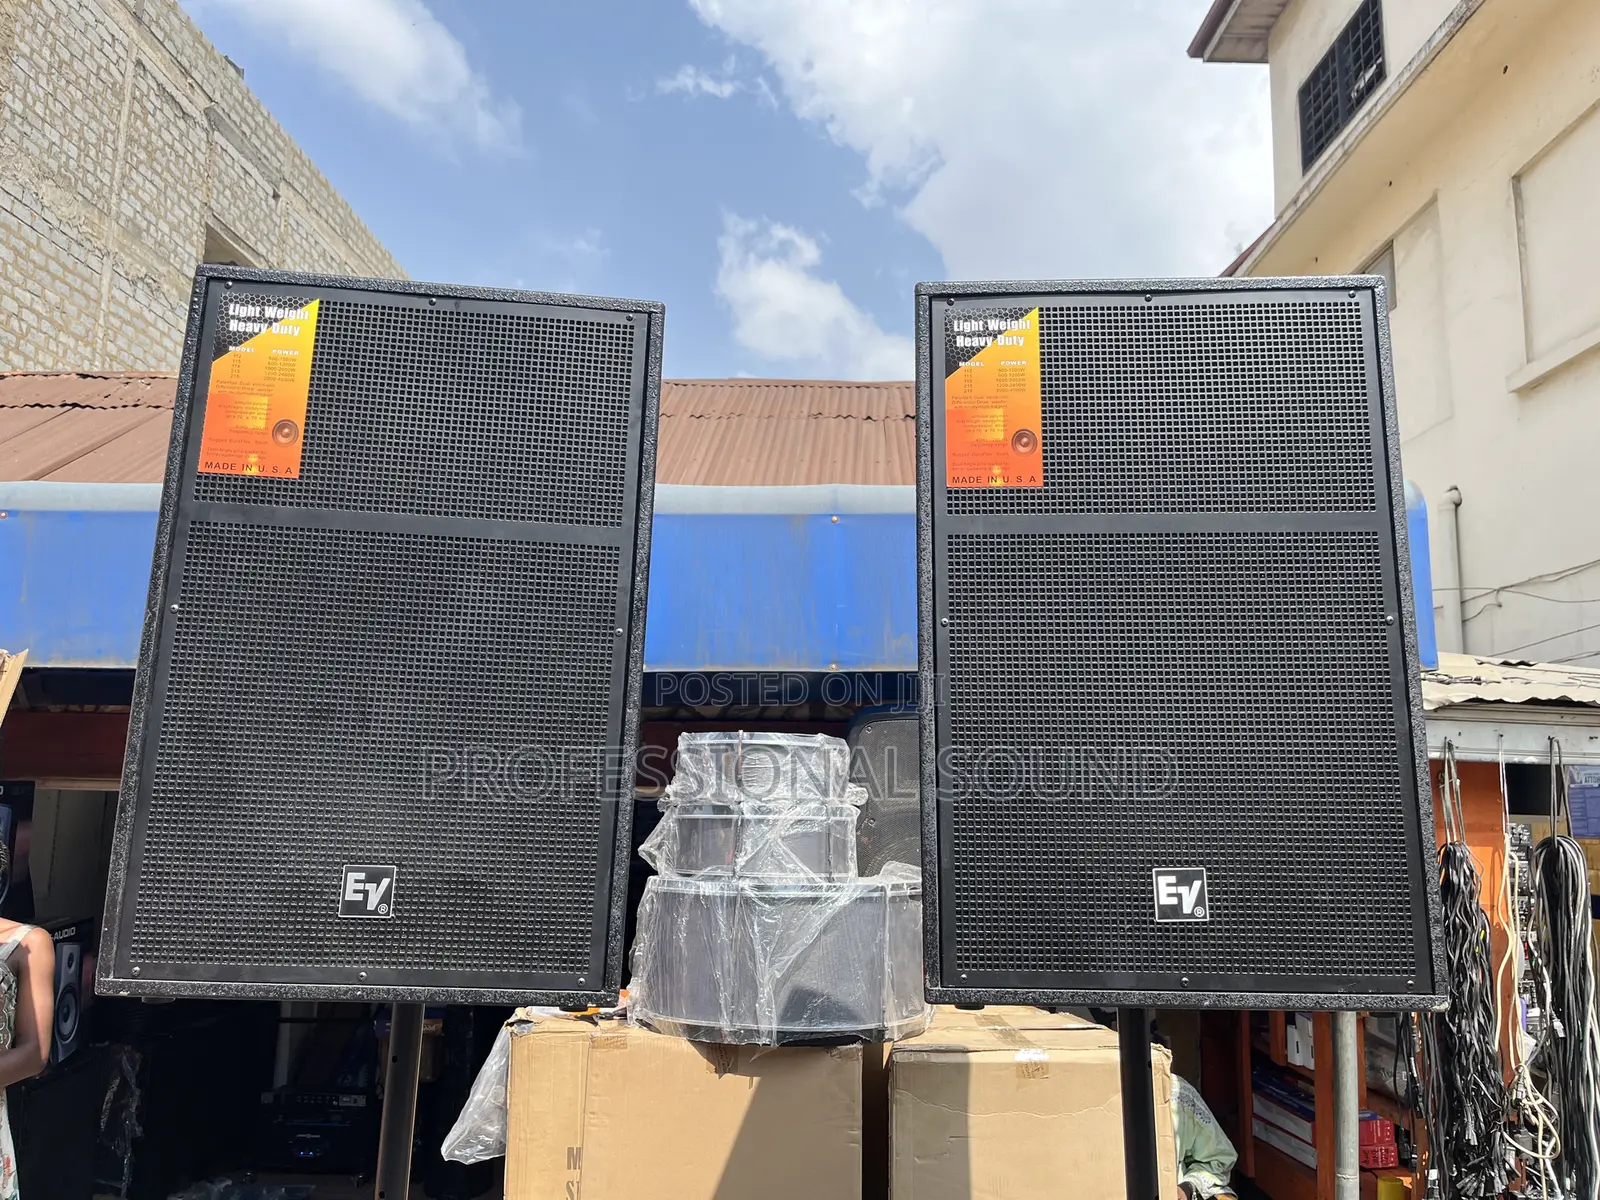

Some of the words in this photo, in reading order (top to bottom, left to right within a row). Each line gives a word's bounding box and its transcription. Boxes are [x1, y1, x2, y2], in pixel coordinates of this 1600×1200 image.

[229, 304, 260, 318] Light
[264, 306, 309, 320] Weight
[229, 320, 268, 334] Heavy
[271, 322, 300, 336] Duty
[953, 320, 984, 332] Light
[987, 319, 1031, 331] Weight
[956, 335, 993, 347] Heavy
[997, 335, 1024, 346] Duty
[204, 461, 237, 471] MADE
[241, 463, 253, 471] IN
[952, 476, 982, 484] MADE
[987, 475, 998, 483] IN
[1029, 475, 1037, 483] A
